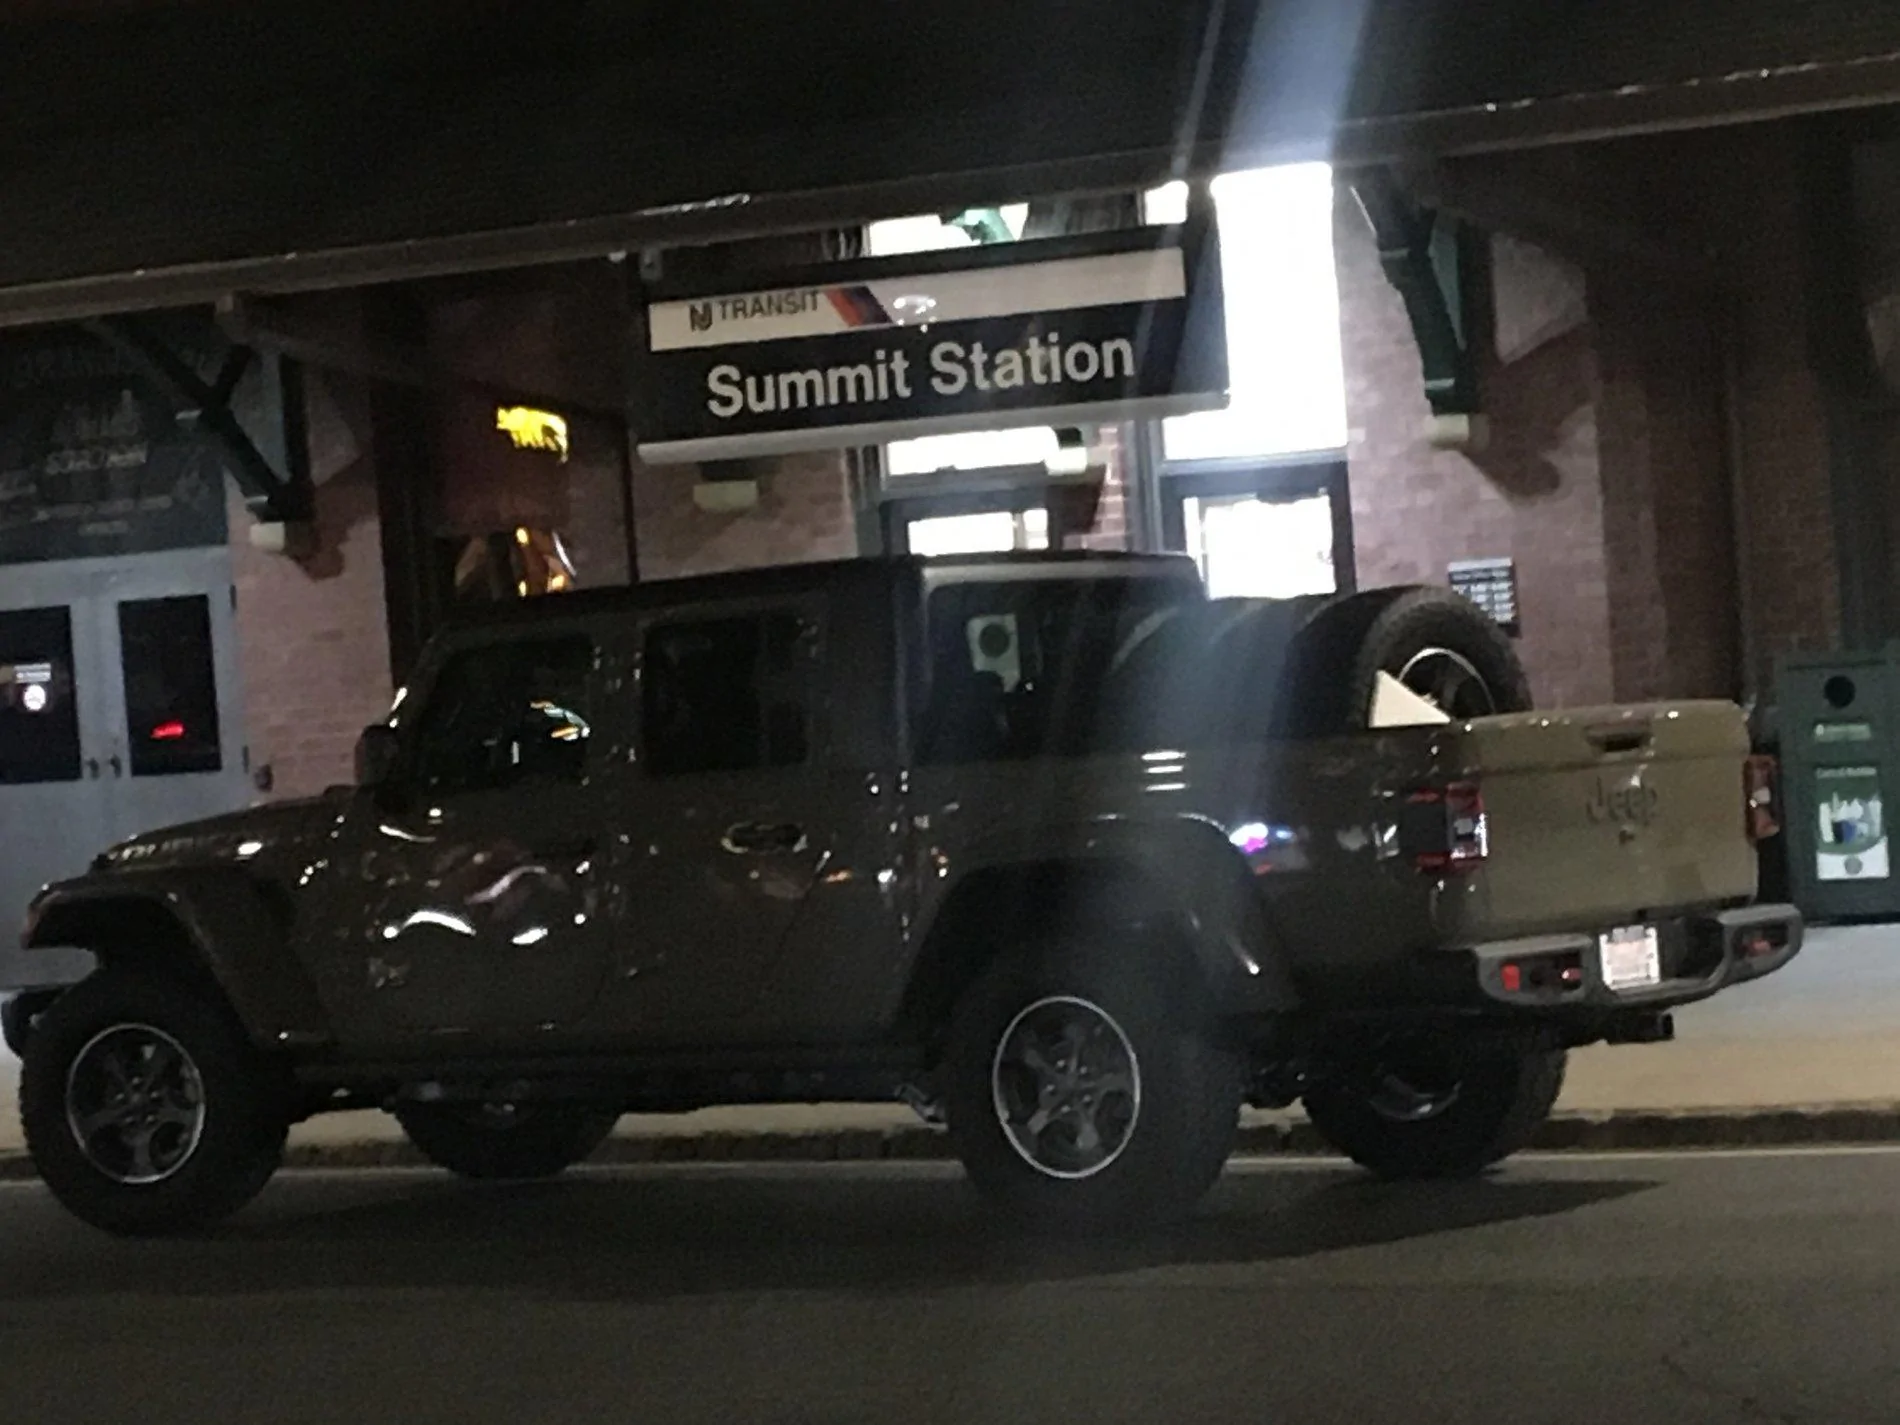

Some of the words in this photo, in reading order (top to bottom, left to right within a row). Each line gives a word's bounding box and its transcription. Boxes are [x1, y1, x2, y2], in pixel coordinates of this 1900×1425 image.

[717, 289, 819, 321] TRANSIT
[708, 349, 911, 417] Summit
[930, 333, 1135, 396] Station
[1586, 775, 1658, 828] Jeep
